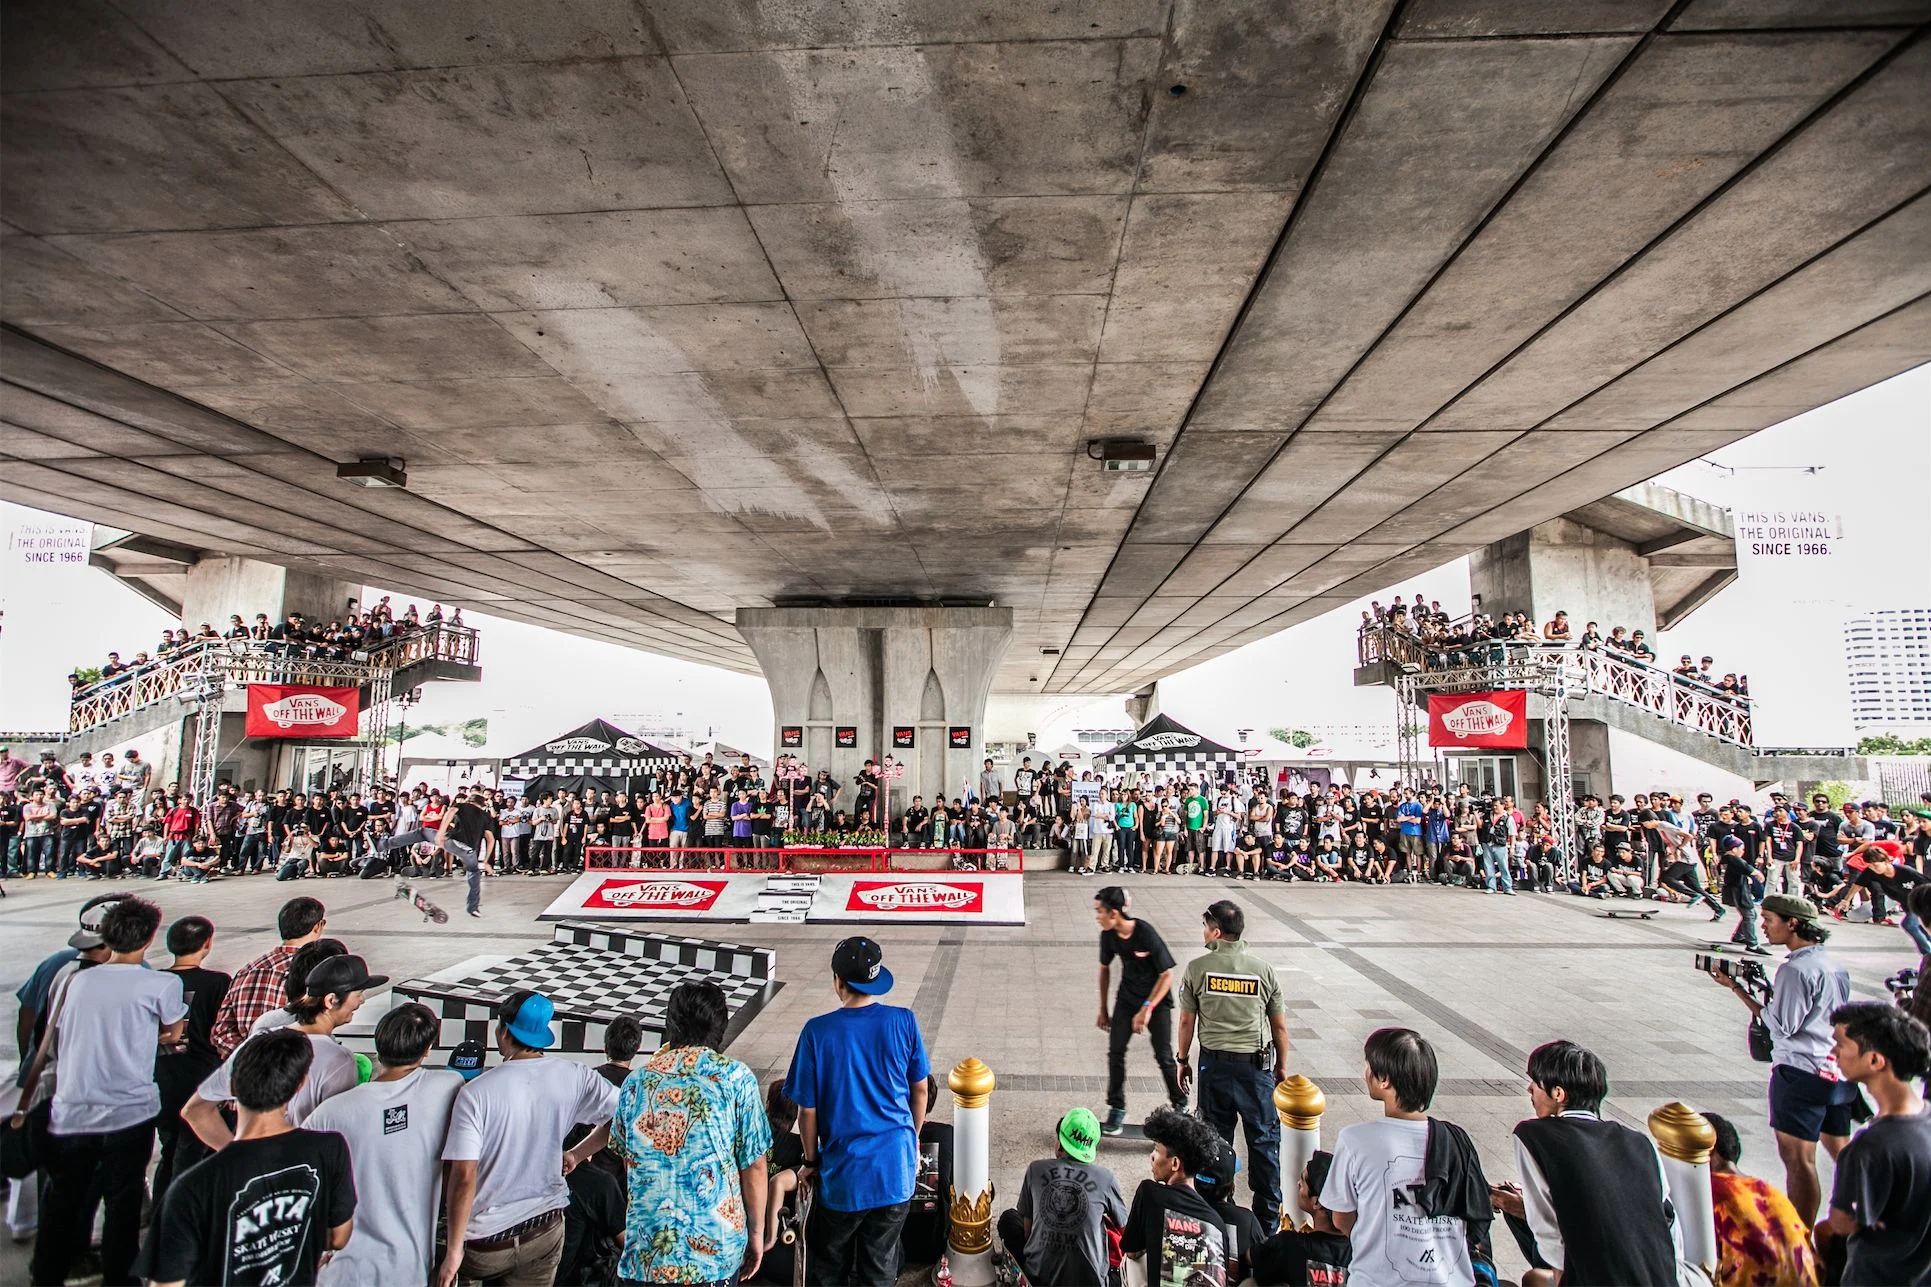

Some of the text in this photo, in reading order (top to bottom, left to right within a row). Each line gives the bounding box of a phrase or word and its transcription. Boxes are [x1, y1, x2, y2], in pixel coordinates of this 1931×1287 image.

[1740, 511, 1830, 523] THIS IS VANS.
[1739, 527, 1831, 539] THE ORIGINAL
[17, 537, 87, 549] THE ORIGINAL
[1752, 543, 1832, 556] SINCE 1966.
[25, 552, 55, 563] SINCE
[289, 698, 319, 708] VANS
[273, 707, 339, 720] OFF THE WALL
[1462, 706, 1488, 717] VANS
[1450, 713, 1507, 730] OFF THE WALL
[640, 884, 680, 892] VANS
[894, 886, 937, 894] VANS
[611, 890, 707, 901] OFF THE WALL
[870, 892, 968, 903] OFF THE WALL
[1210, 977, 1256, 994] SECURITY
[1040, 1167, 1098, 1193] JETDO
[235, 1195, 309, 1243] ATTA
[1392, 1213, 1424, 1226] SKATE
[1166, 1217, 1201, 1235] VANS
[1310, 1269, 1345, 1285] VANS
